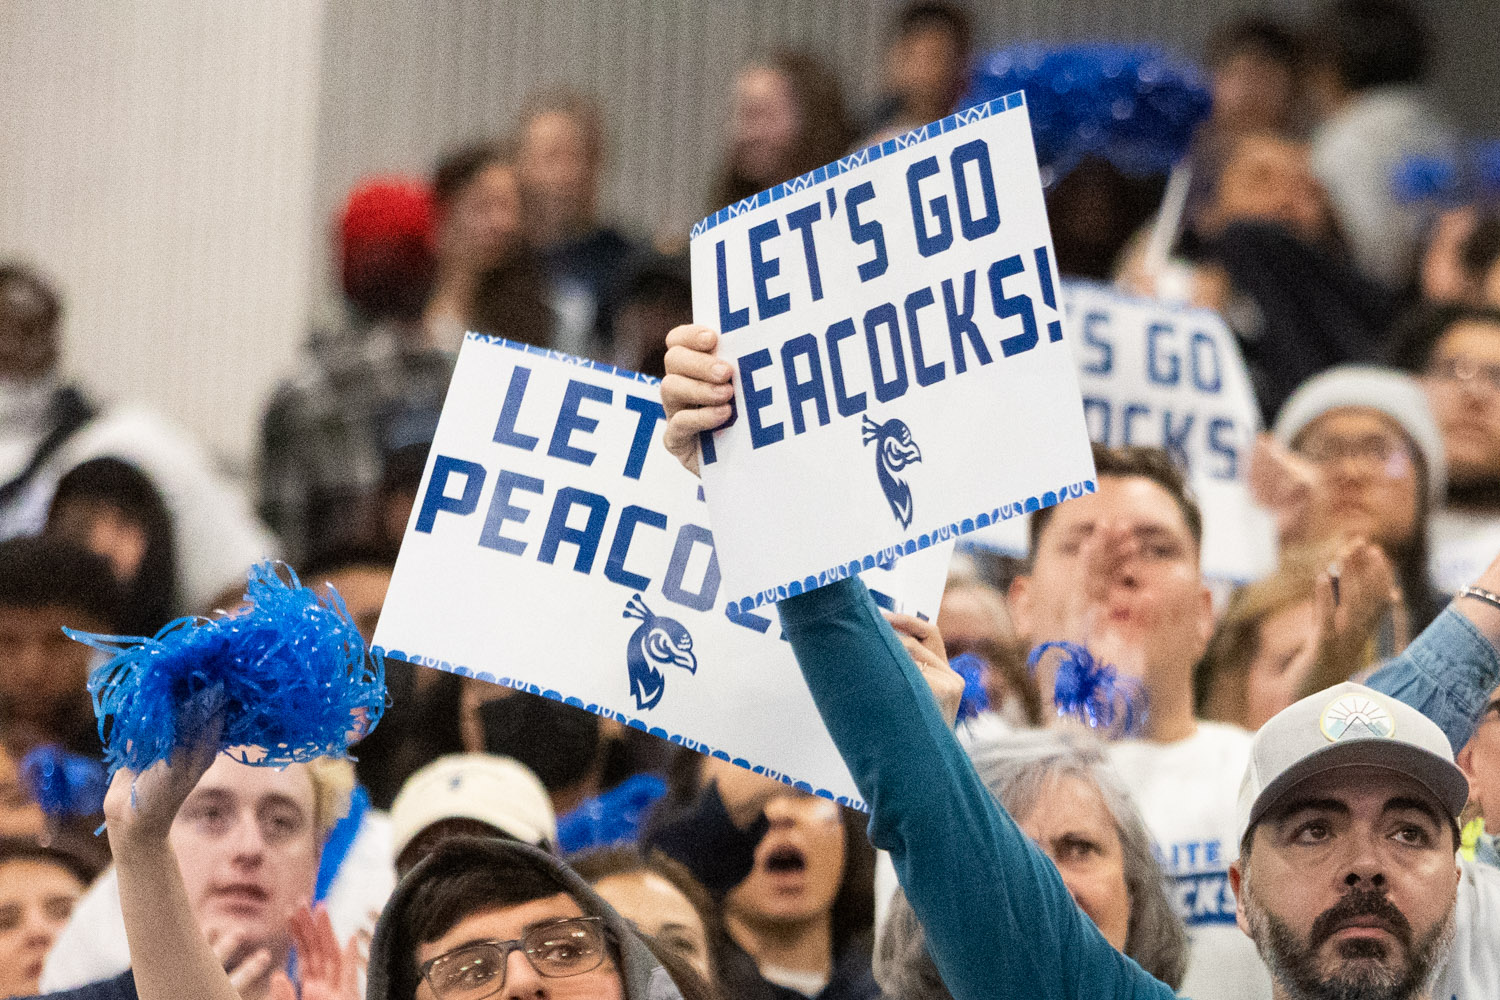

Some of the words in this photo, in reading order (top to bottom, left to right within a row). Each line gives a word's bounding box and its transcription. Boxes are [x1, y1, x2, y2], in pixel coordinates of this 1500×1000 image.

[714, 180, 889, 335] LET'S
[905, 138, 1001, 259] GO
[1146, 320, 1222, 394] GO
[492, 365, 669, 480] LET
